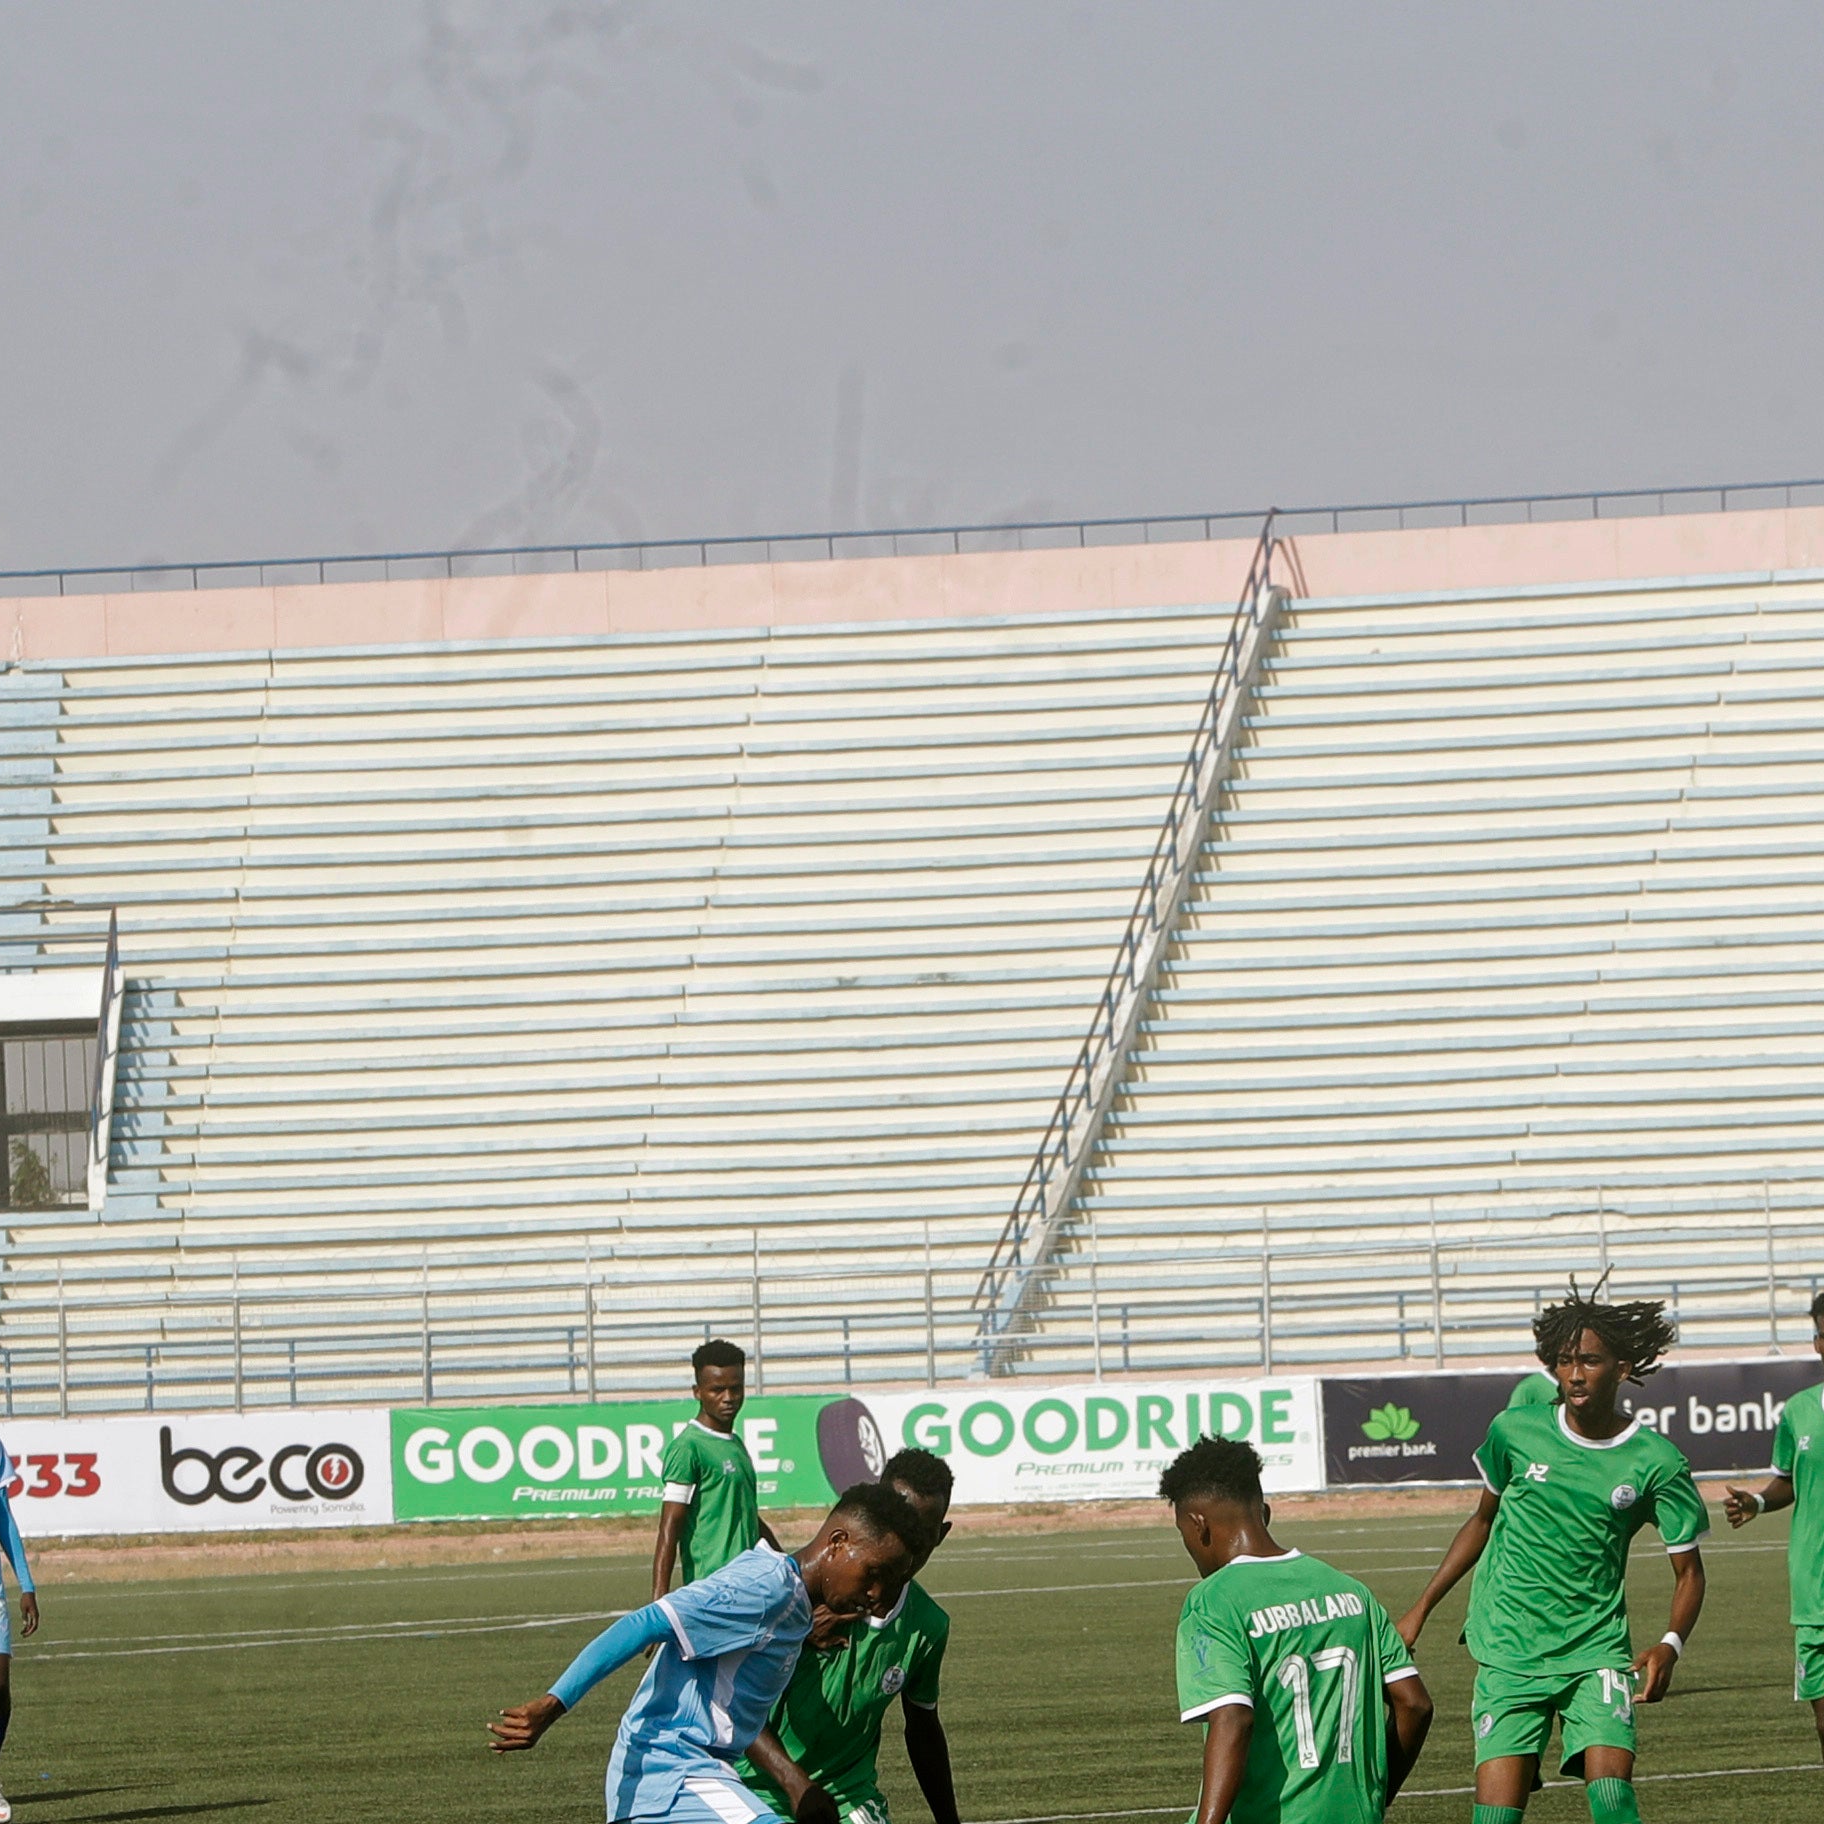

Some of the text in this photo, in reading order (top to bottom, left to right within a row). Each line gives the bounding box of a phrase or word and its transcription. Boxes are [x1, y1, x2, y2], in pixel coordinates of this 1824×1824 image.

[1688, 1392, 1787, 1435] bank
[160, 1425, 365, 1506] beco
[1348, 1441, 1437, 1462] premier bank
[1014, 1460, 1125, 1477] PREMIUM
[270, 1502, 319, 1515] Powering
[512, 1485, 664, 1502] PREMIUM TRU
[1249, 1592, 1364, 1639] JUBBALAND
[1276, 1645, 1359, 1770] 17
